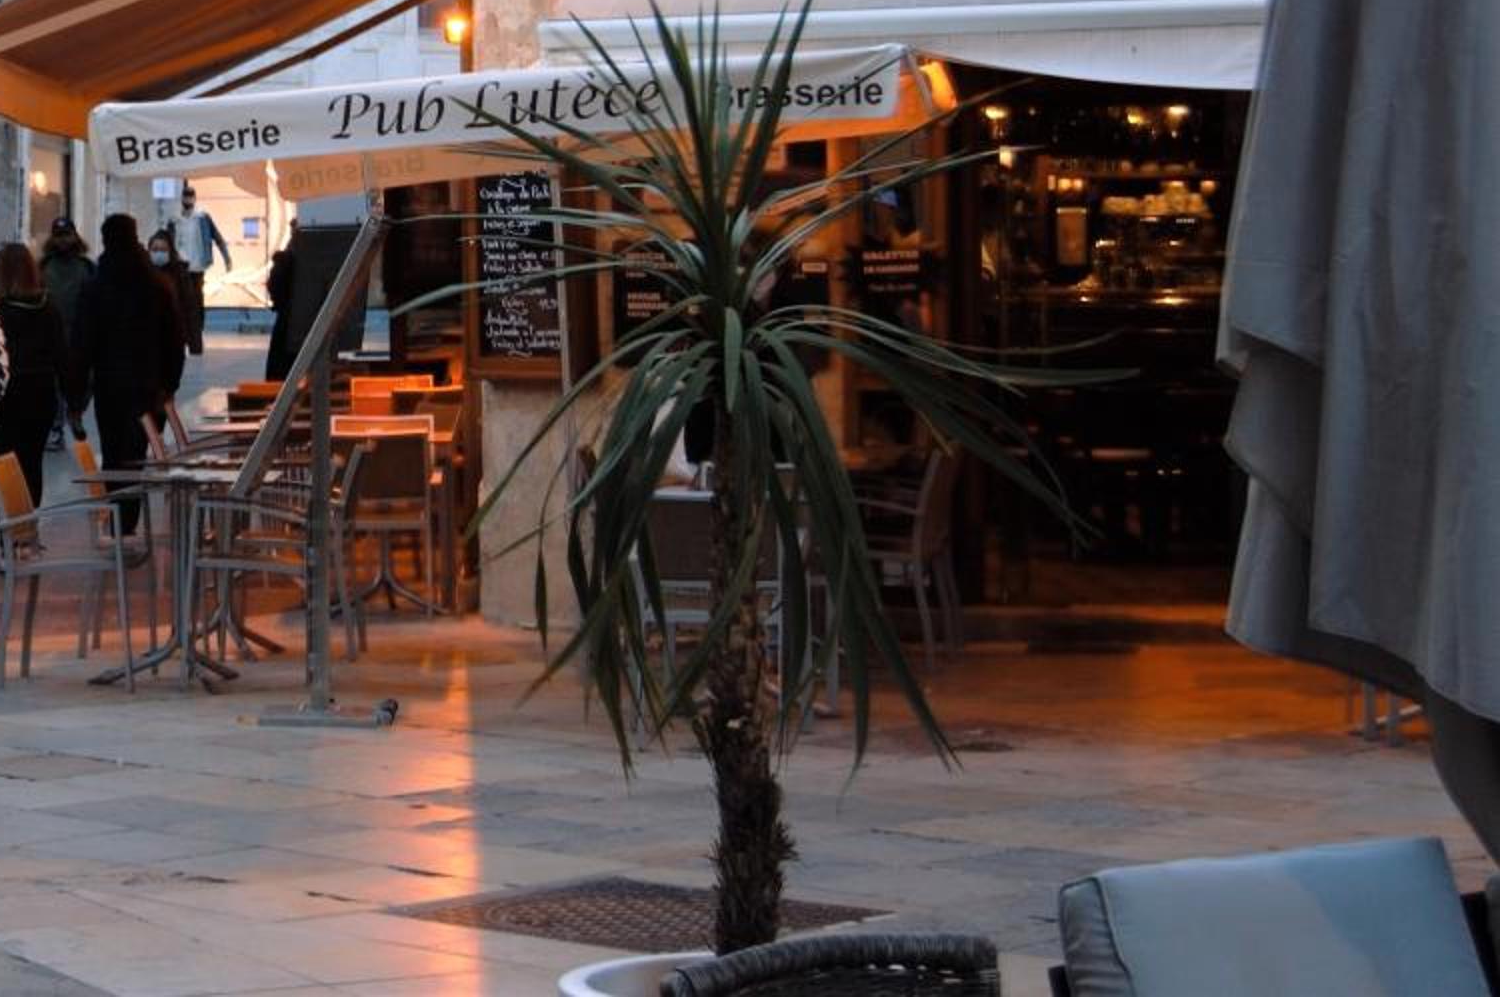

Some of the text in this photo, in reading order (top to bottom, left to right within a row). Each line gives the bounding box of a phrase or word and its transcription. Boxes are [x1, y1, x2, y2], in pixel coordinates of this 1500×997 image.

[116, 119, 281, 165] Brasserie
[328, 80, 446, 140] Pub
[463, 71, 662, 130] Lutèce
